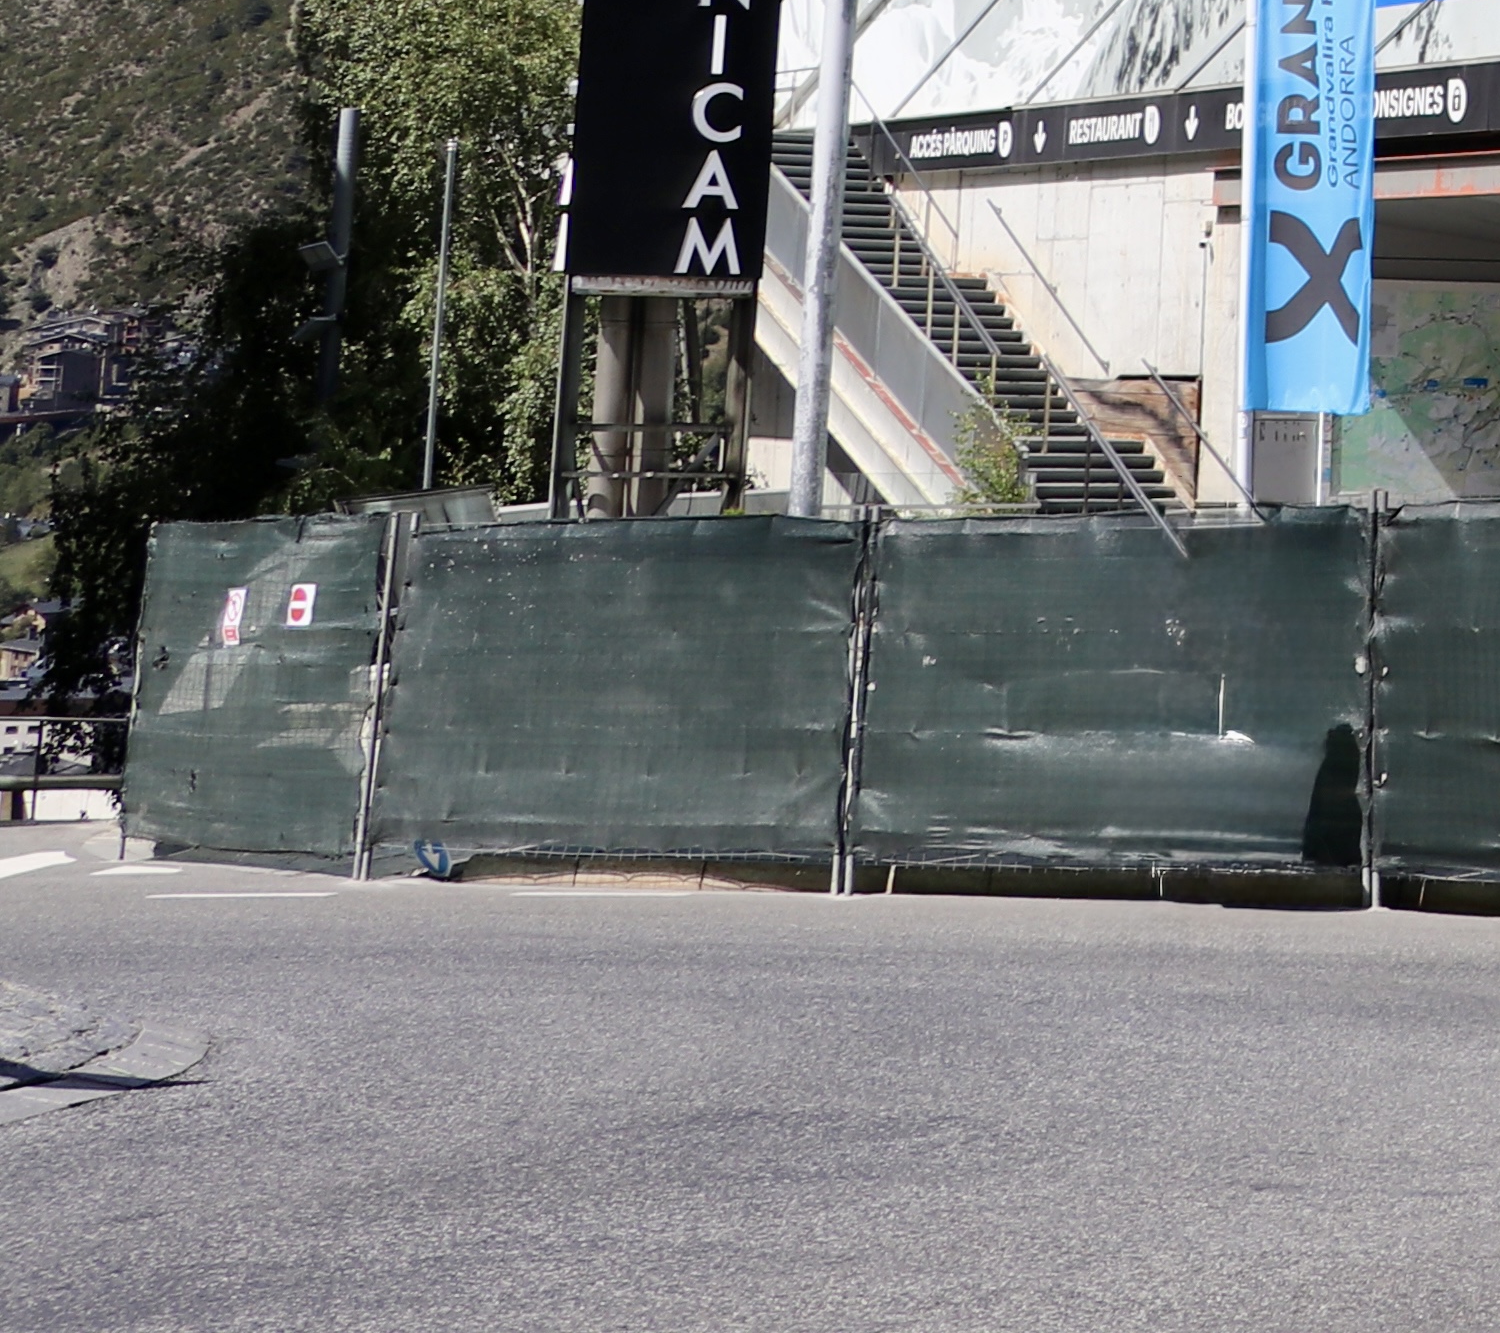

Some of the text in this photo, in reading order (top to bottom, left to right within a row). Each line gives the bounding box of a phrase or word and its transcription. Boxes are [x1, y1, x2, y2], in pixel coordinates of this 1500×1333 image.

[909, 128, 942, 158] ACCÉS
[1068, 112, 1143, 145] RESTAURANT
[1322, 17, 1338, 188] Grandvalira
[1339, 35, 1360, 190] ANDORRA
